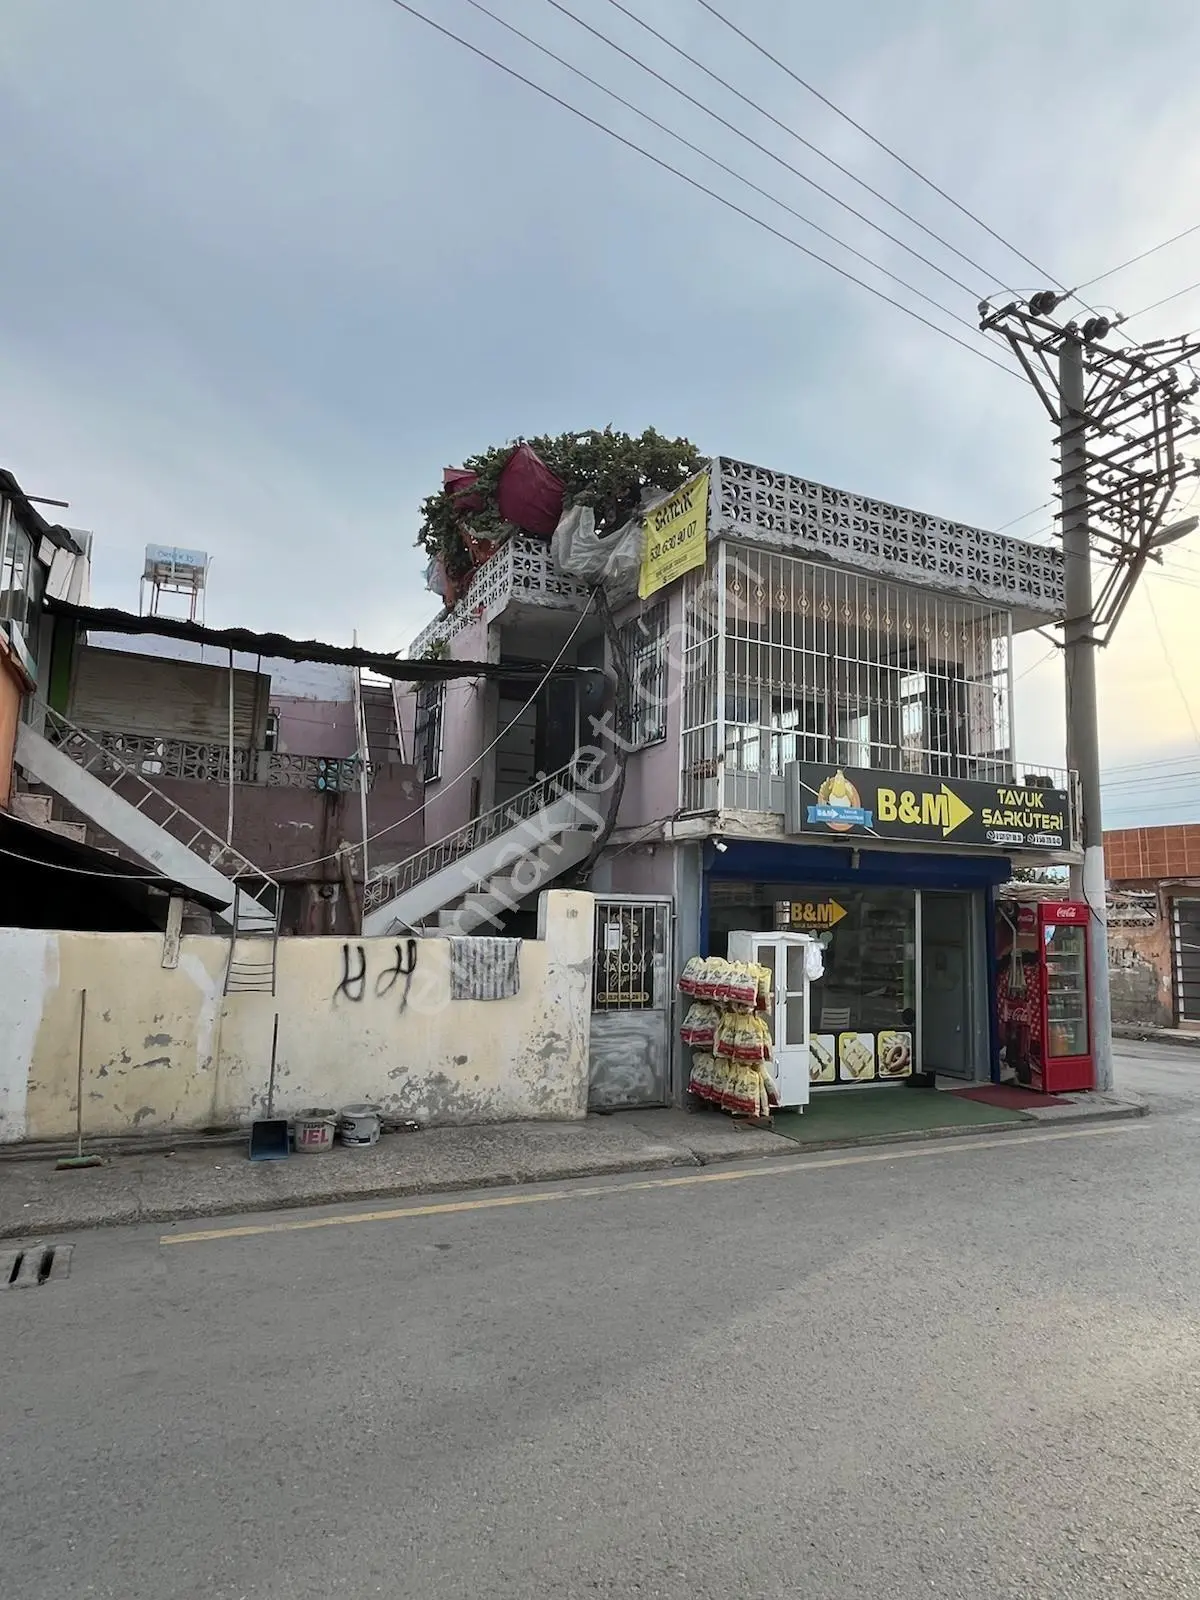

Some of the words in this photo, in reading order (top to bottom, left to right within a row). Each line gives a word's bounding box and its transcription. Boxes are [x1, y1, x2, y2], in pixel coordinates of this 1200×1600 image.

[655, 488, 694, 532] SATILIK
[687, 520, 697, 538] 07
[877, 788, 949, 827] B&M
[996, 788, 1045, 809] TAVUK
[981, 808, 1064, 831] ŞARKÜTERİ
[791, 902, 833, 922] B&M
[299, 1129, 329, 1145] JEL
